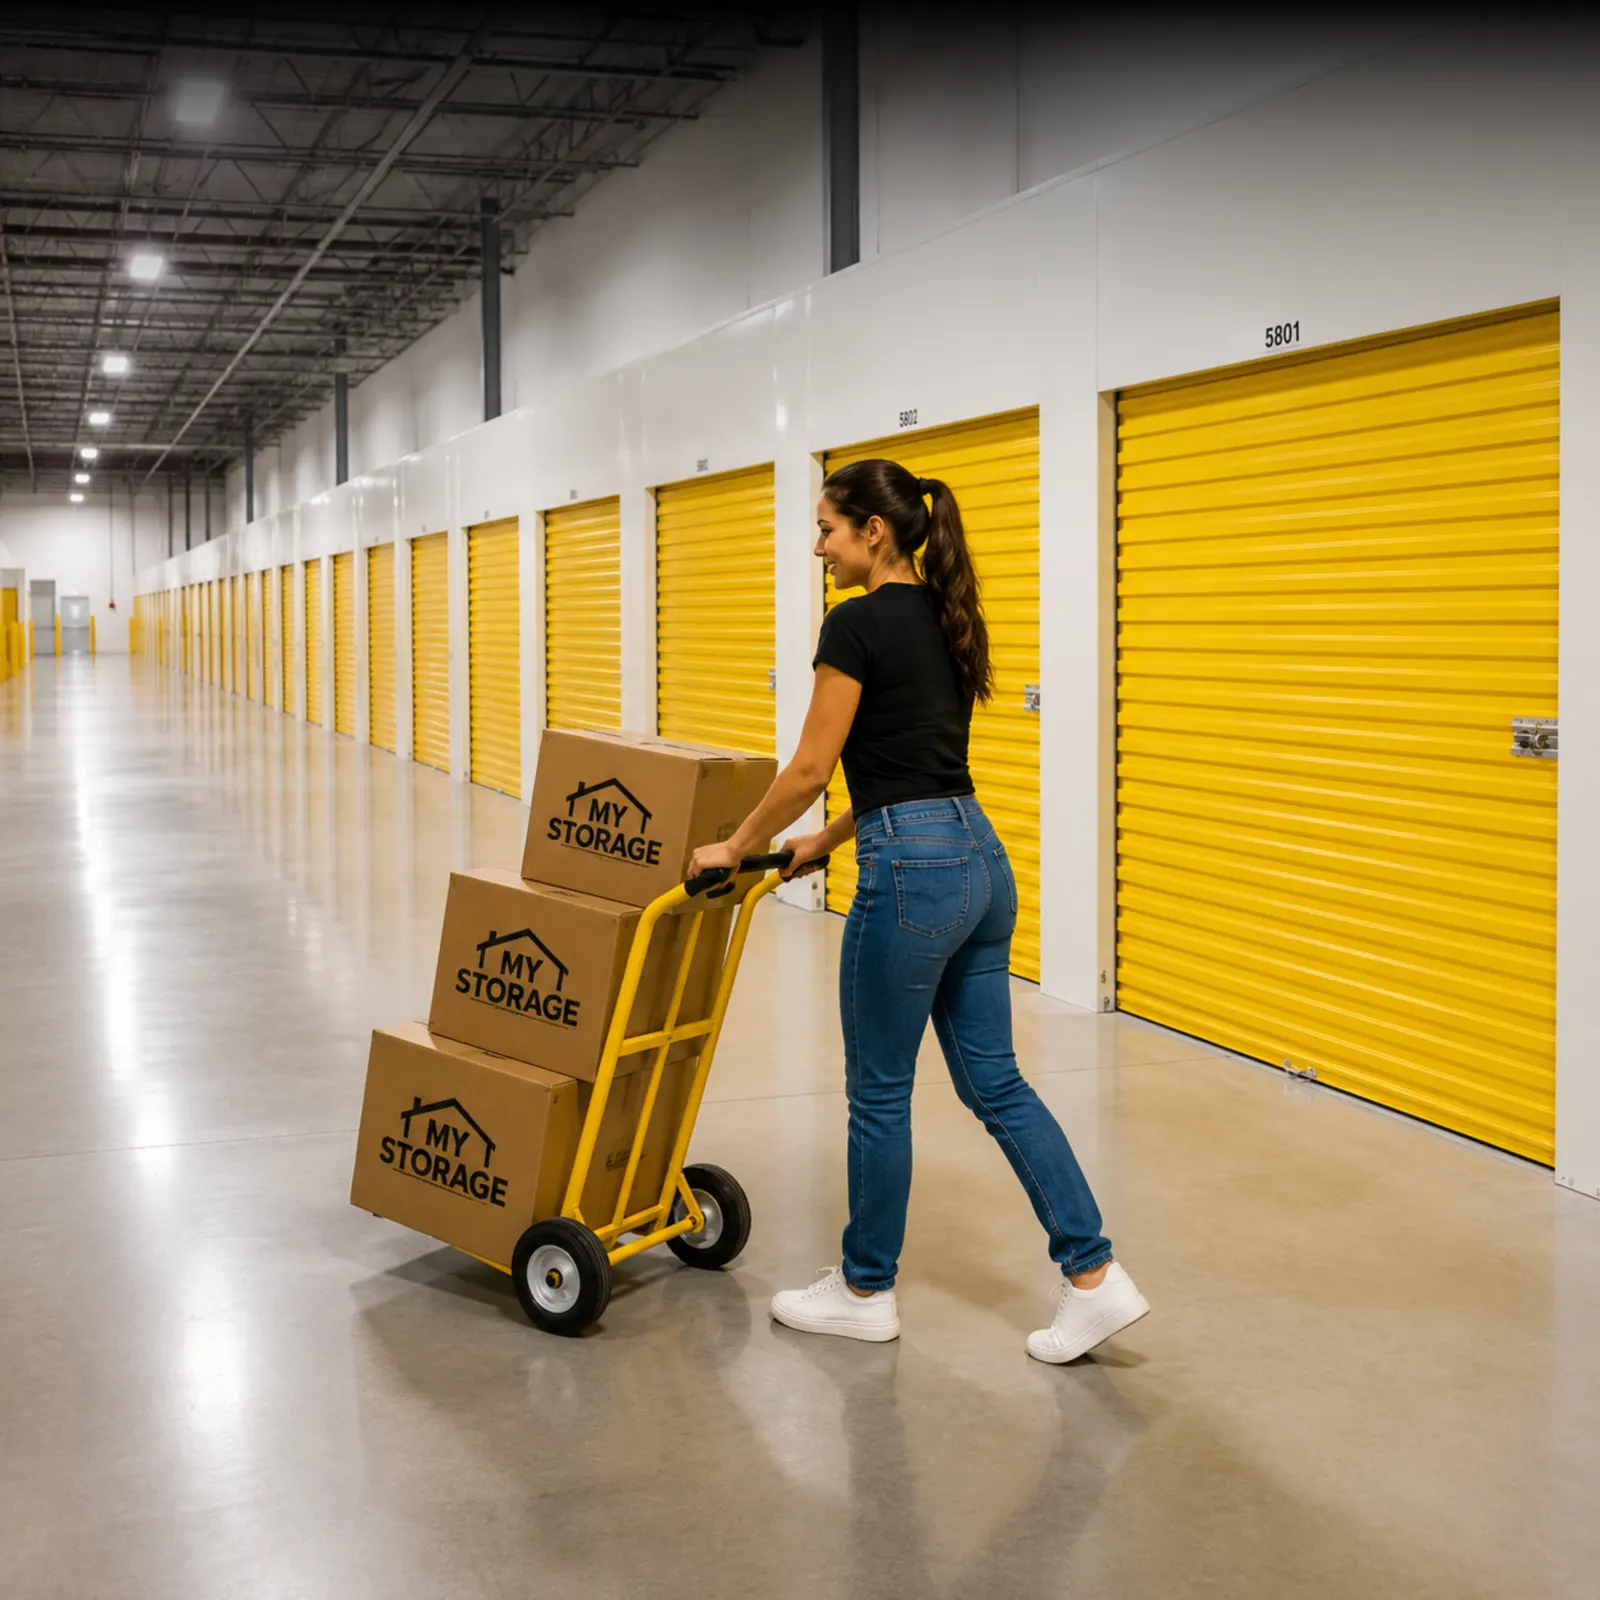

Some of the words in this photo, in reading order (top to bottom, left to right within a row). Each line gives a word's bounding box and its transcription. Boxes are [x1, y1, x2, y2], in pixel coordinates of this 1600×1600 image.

[1265, 320, 1300, 348] 5801
[899, 409, 918, 428] 5802
[588, 798, 629, 829] MY
[547, 816, 663, 867] STORAGE
[500, 949, 544, 984] MY
[454, 967, 581, 1028] STORAGE
[425, 1117, 471, 1159] MY
[379, 1135, 509, 1209] STORAGE
